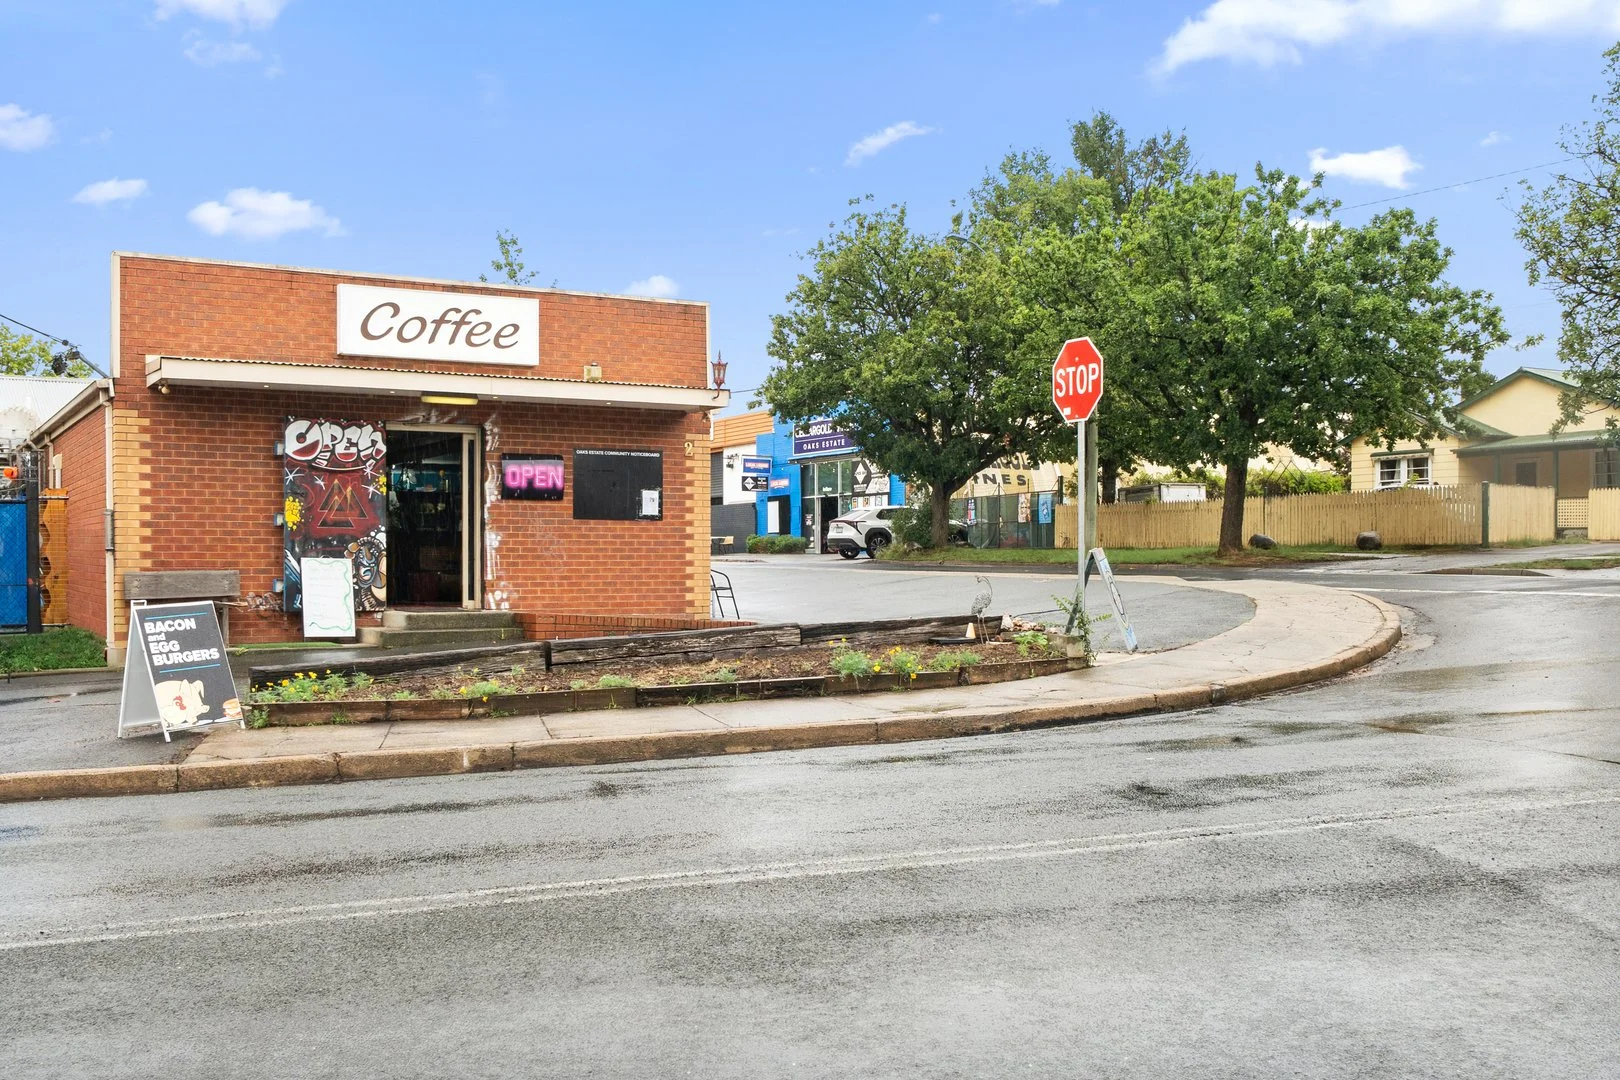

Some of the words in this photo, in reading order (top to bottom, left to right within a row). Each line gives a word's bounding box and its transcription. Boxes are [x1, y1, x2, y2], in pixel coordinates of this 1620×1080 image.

[360, 302, 520, 349] Coffee
[1056, 363, 1099, 397] STOP
[685, 442, 694, 456] 2
[803, 442, 820, 450] OAKS
[822, 439, 845, 448] ESTATE
[506, 464, 564, 489] OPEN
[144, 618, 196, 633] BACON
[147, 633, 166, 641] and
[149, 640, 181, 654] EGG
[152, 648, 220, 665] BURGERS
